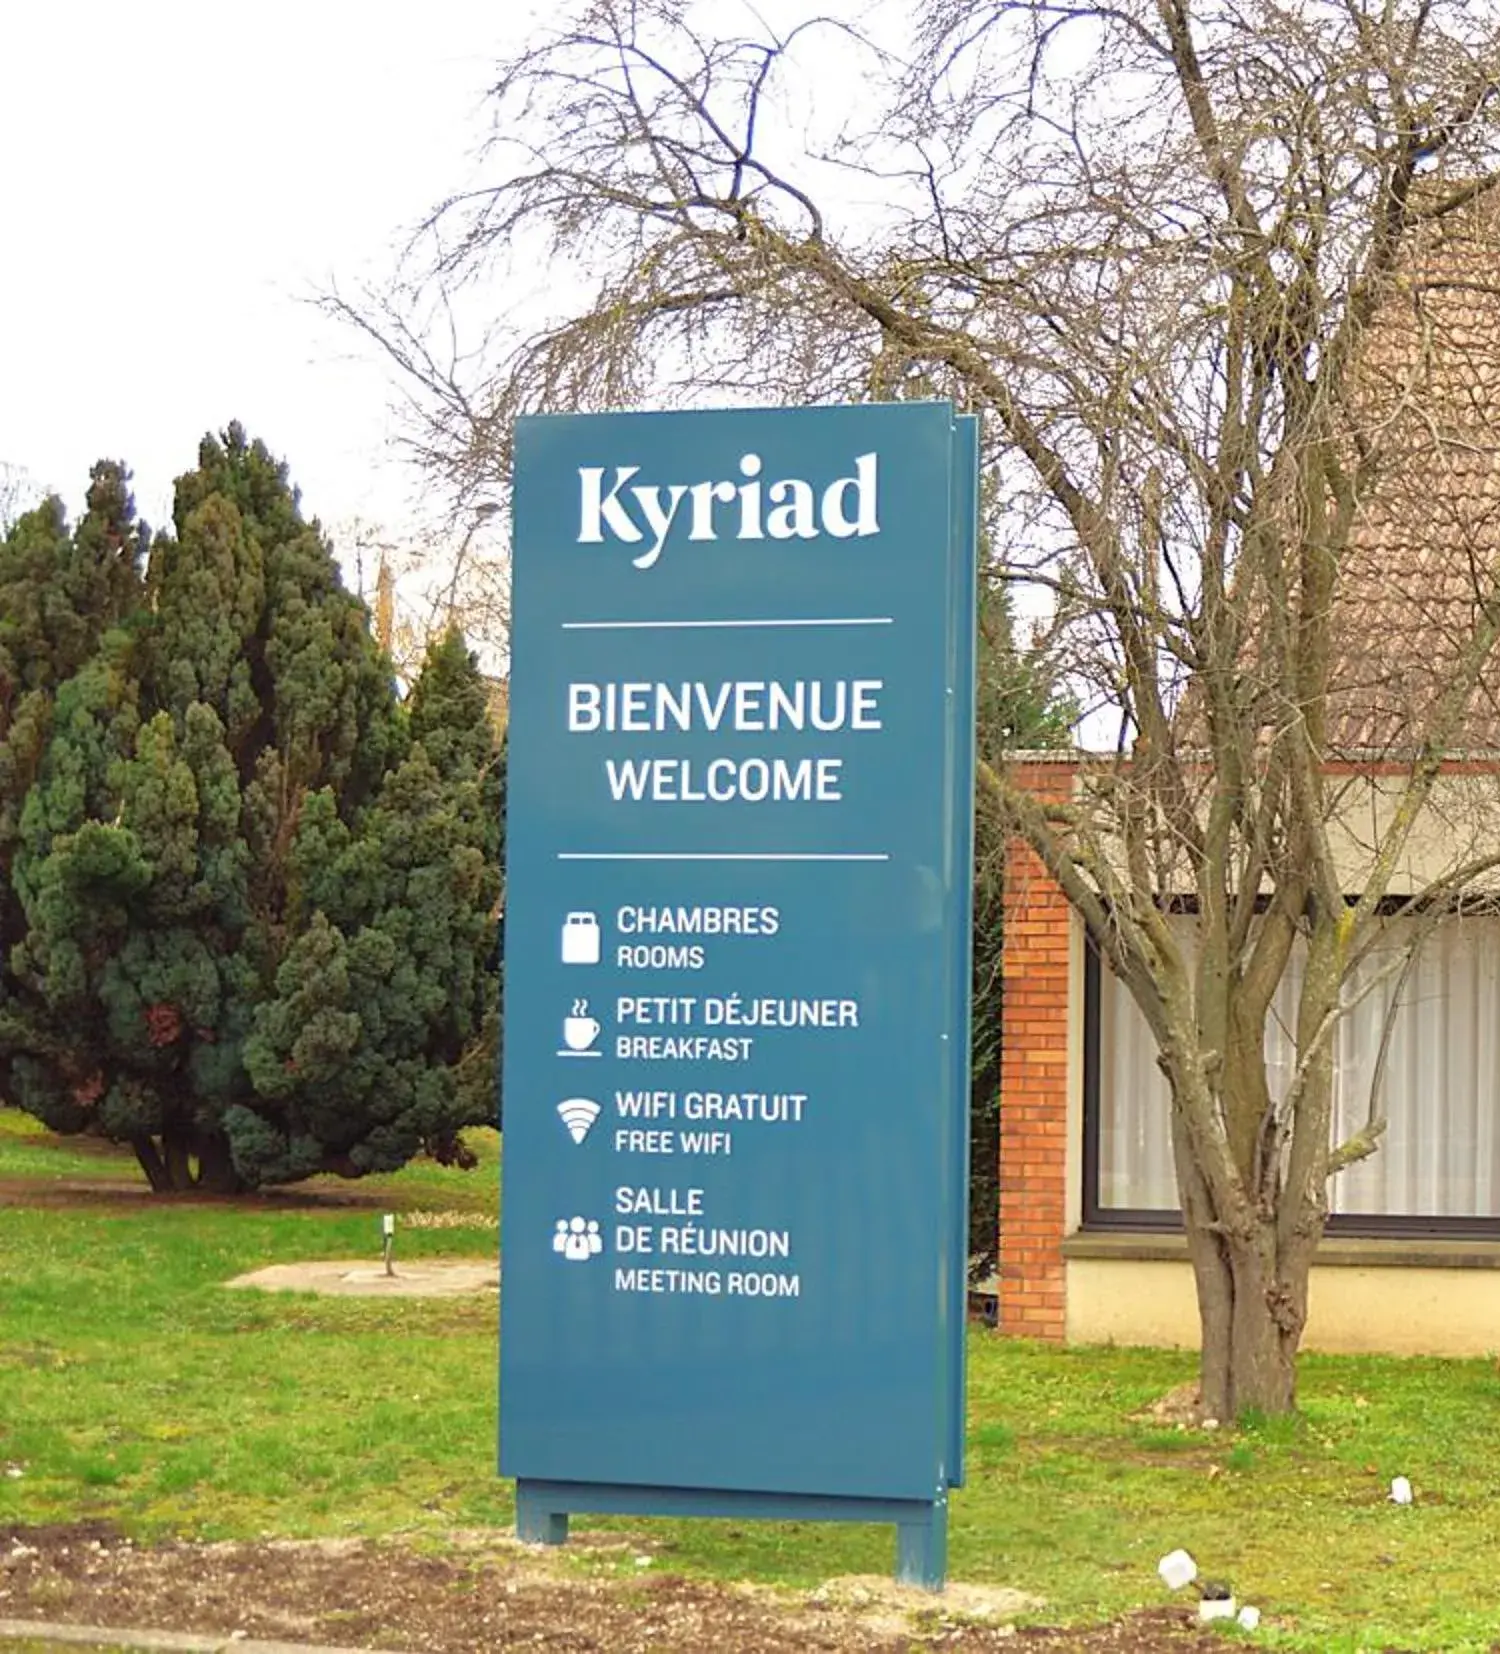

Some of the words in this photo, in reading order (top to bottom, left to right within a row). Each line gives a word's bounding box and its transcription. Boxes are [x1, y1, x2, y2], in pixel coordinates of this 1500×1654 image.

[577, 452, 880, 569] Kyriad
[568, 680, 883, 732] BIENVENUE
[605, 758, 842, 801] WELCOME
[617, 906, 779, 935] CHAMBRES
[617, 945, 704, 969] ROOMS
[616, 997, 696, 1025] PETIT
[705, 992, 858, 1027] DÉJEUNER
[616, 1036, 753, 1060] BREAKFAST
[615, 1092, 676, 1119] WIFI
[684, 1092, 807, 1121] GRATUIT
[616, 1130, 673, 1153] FREE
[680, 1131, 731, 1154] WIFI
[615, 1187, 704, 1215] SALLE
[616, 1226, 653, 1253] DE
[661, 1221, 789, 1257] RÉUNION
[615, 1268, 722, 1293] MEETING
[727, 1272, 799, 1297] ROOM
